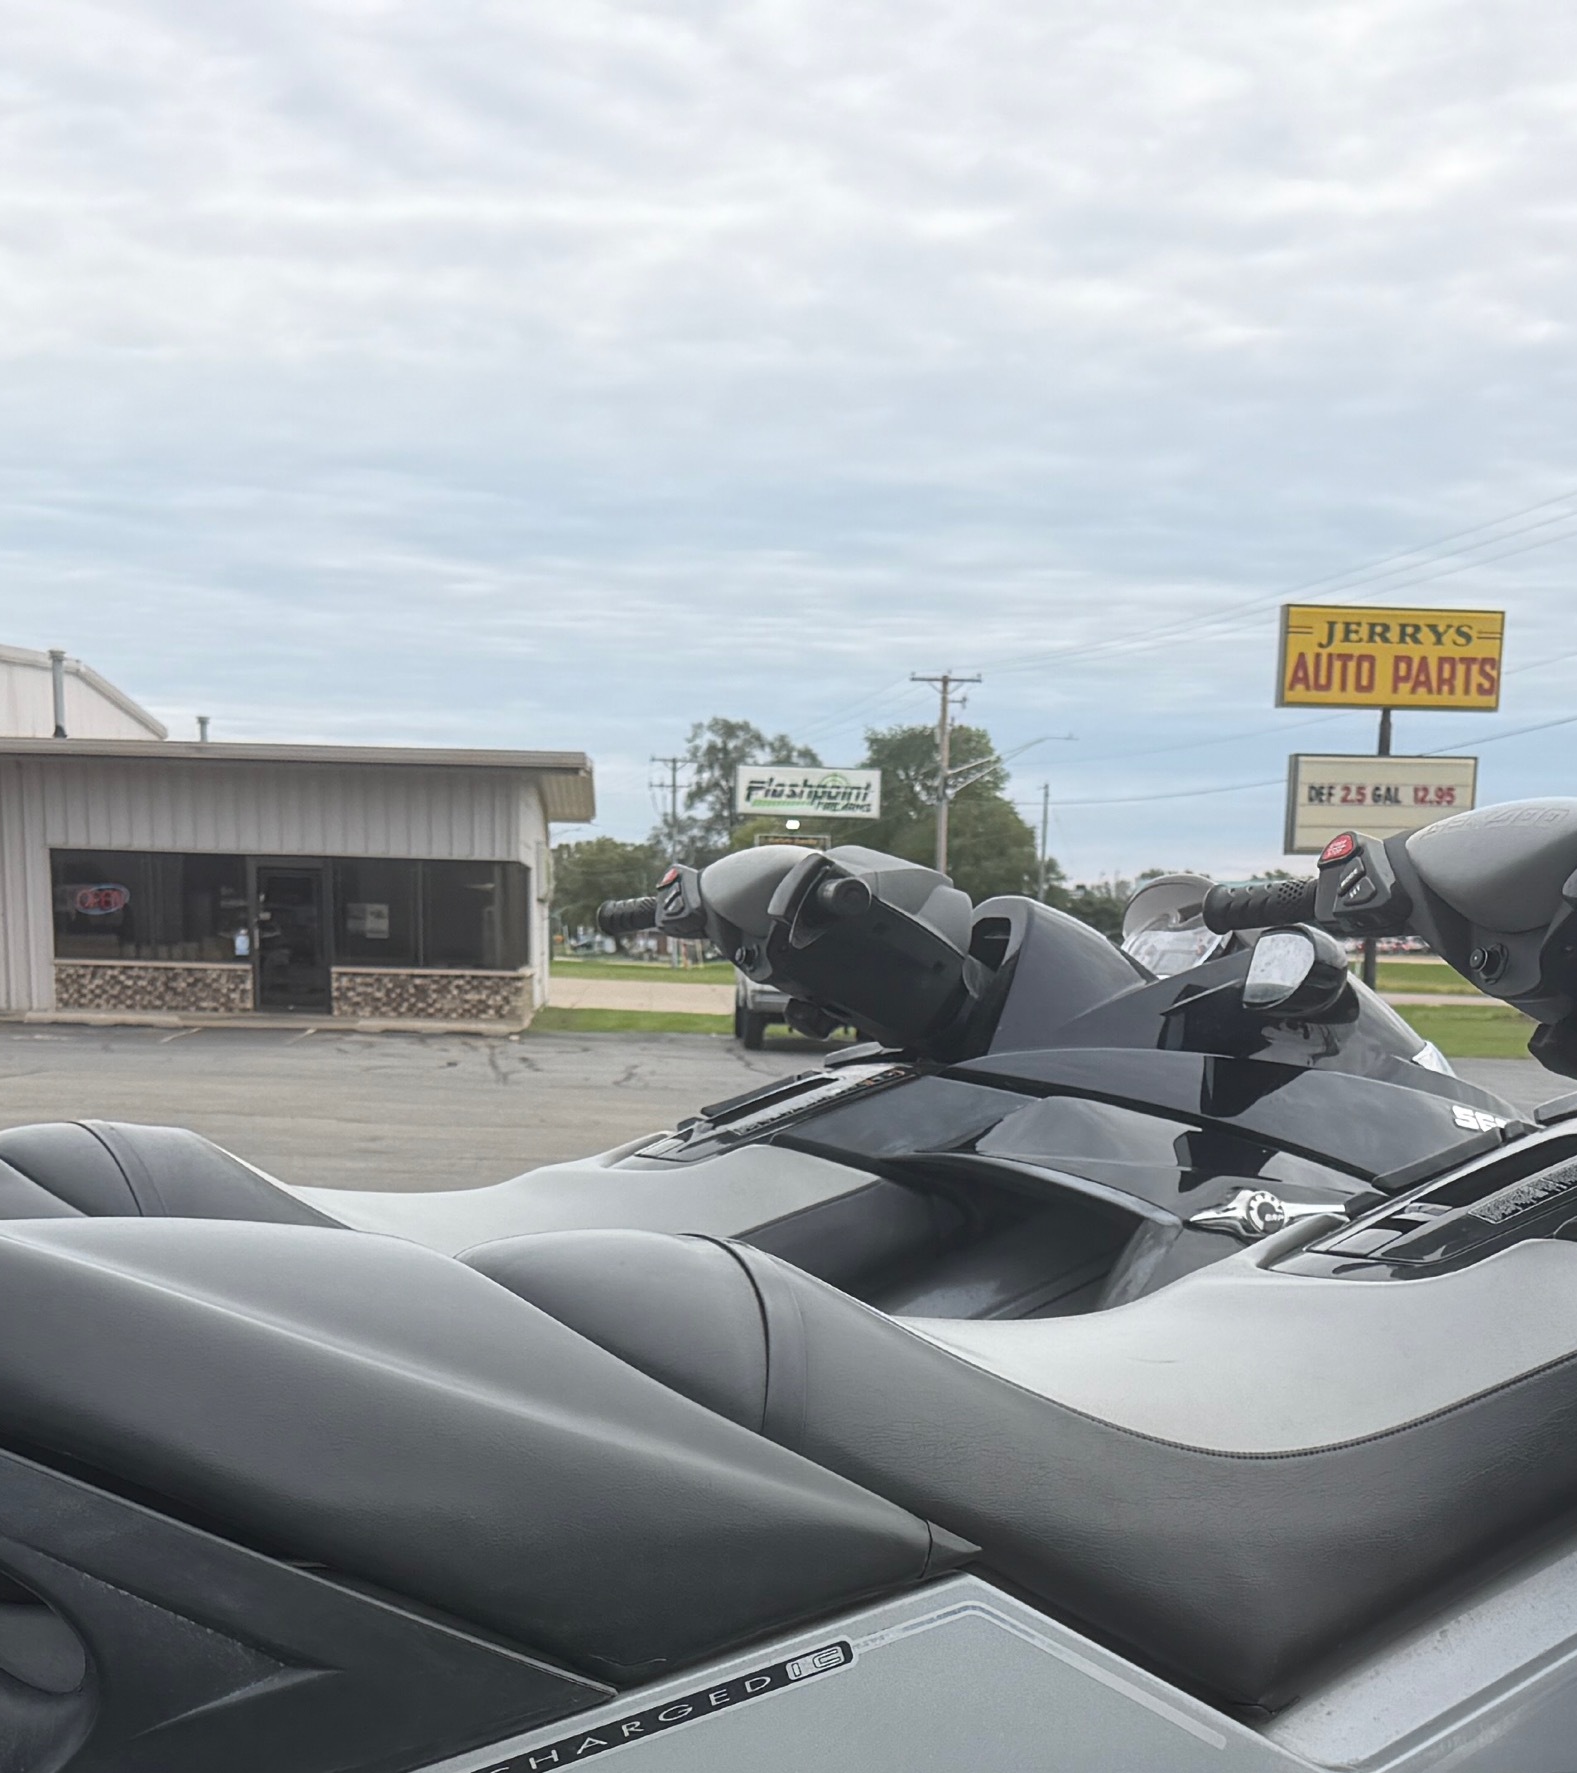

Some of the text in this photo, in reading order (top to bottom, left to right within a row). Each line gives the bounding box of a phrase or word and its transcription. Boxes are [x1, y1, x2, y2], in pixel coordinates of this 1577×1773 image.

[1317, 620, 1474, 649] JERRYS
[1288, 651, 1497, 697] AUTO PARTS
[1308, 785, 1455, 806] DEF 2.5 GAL 12.95
